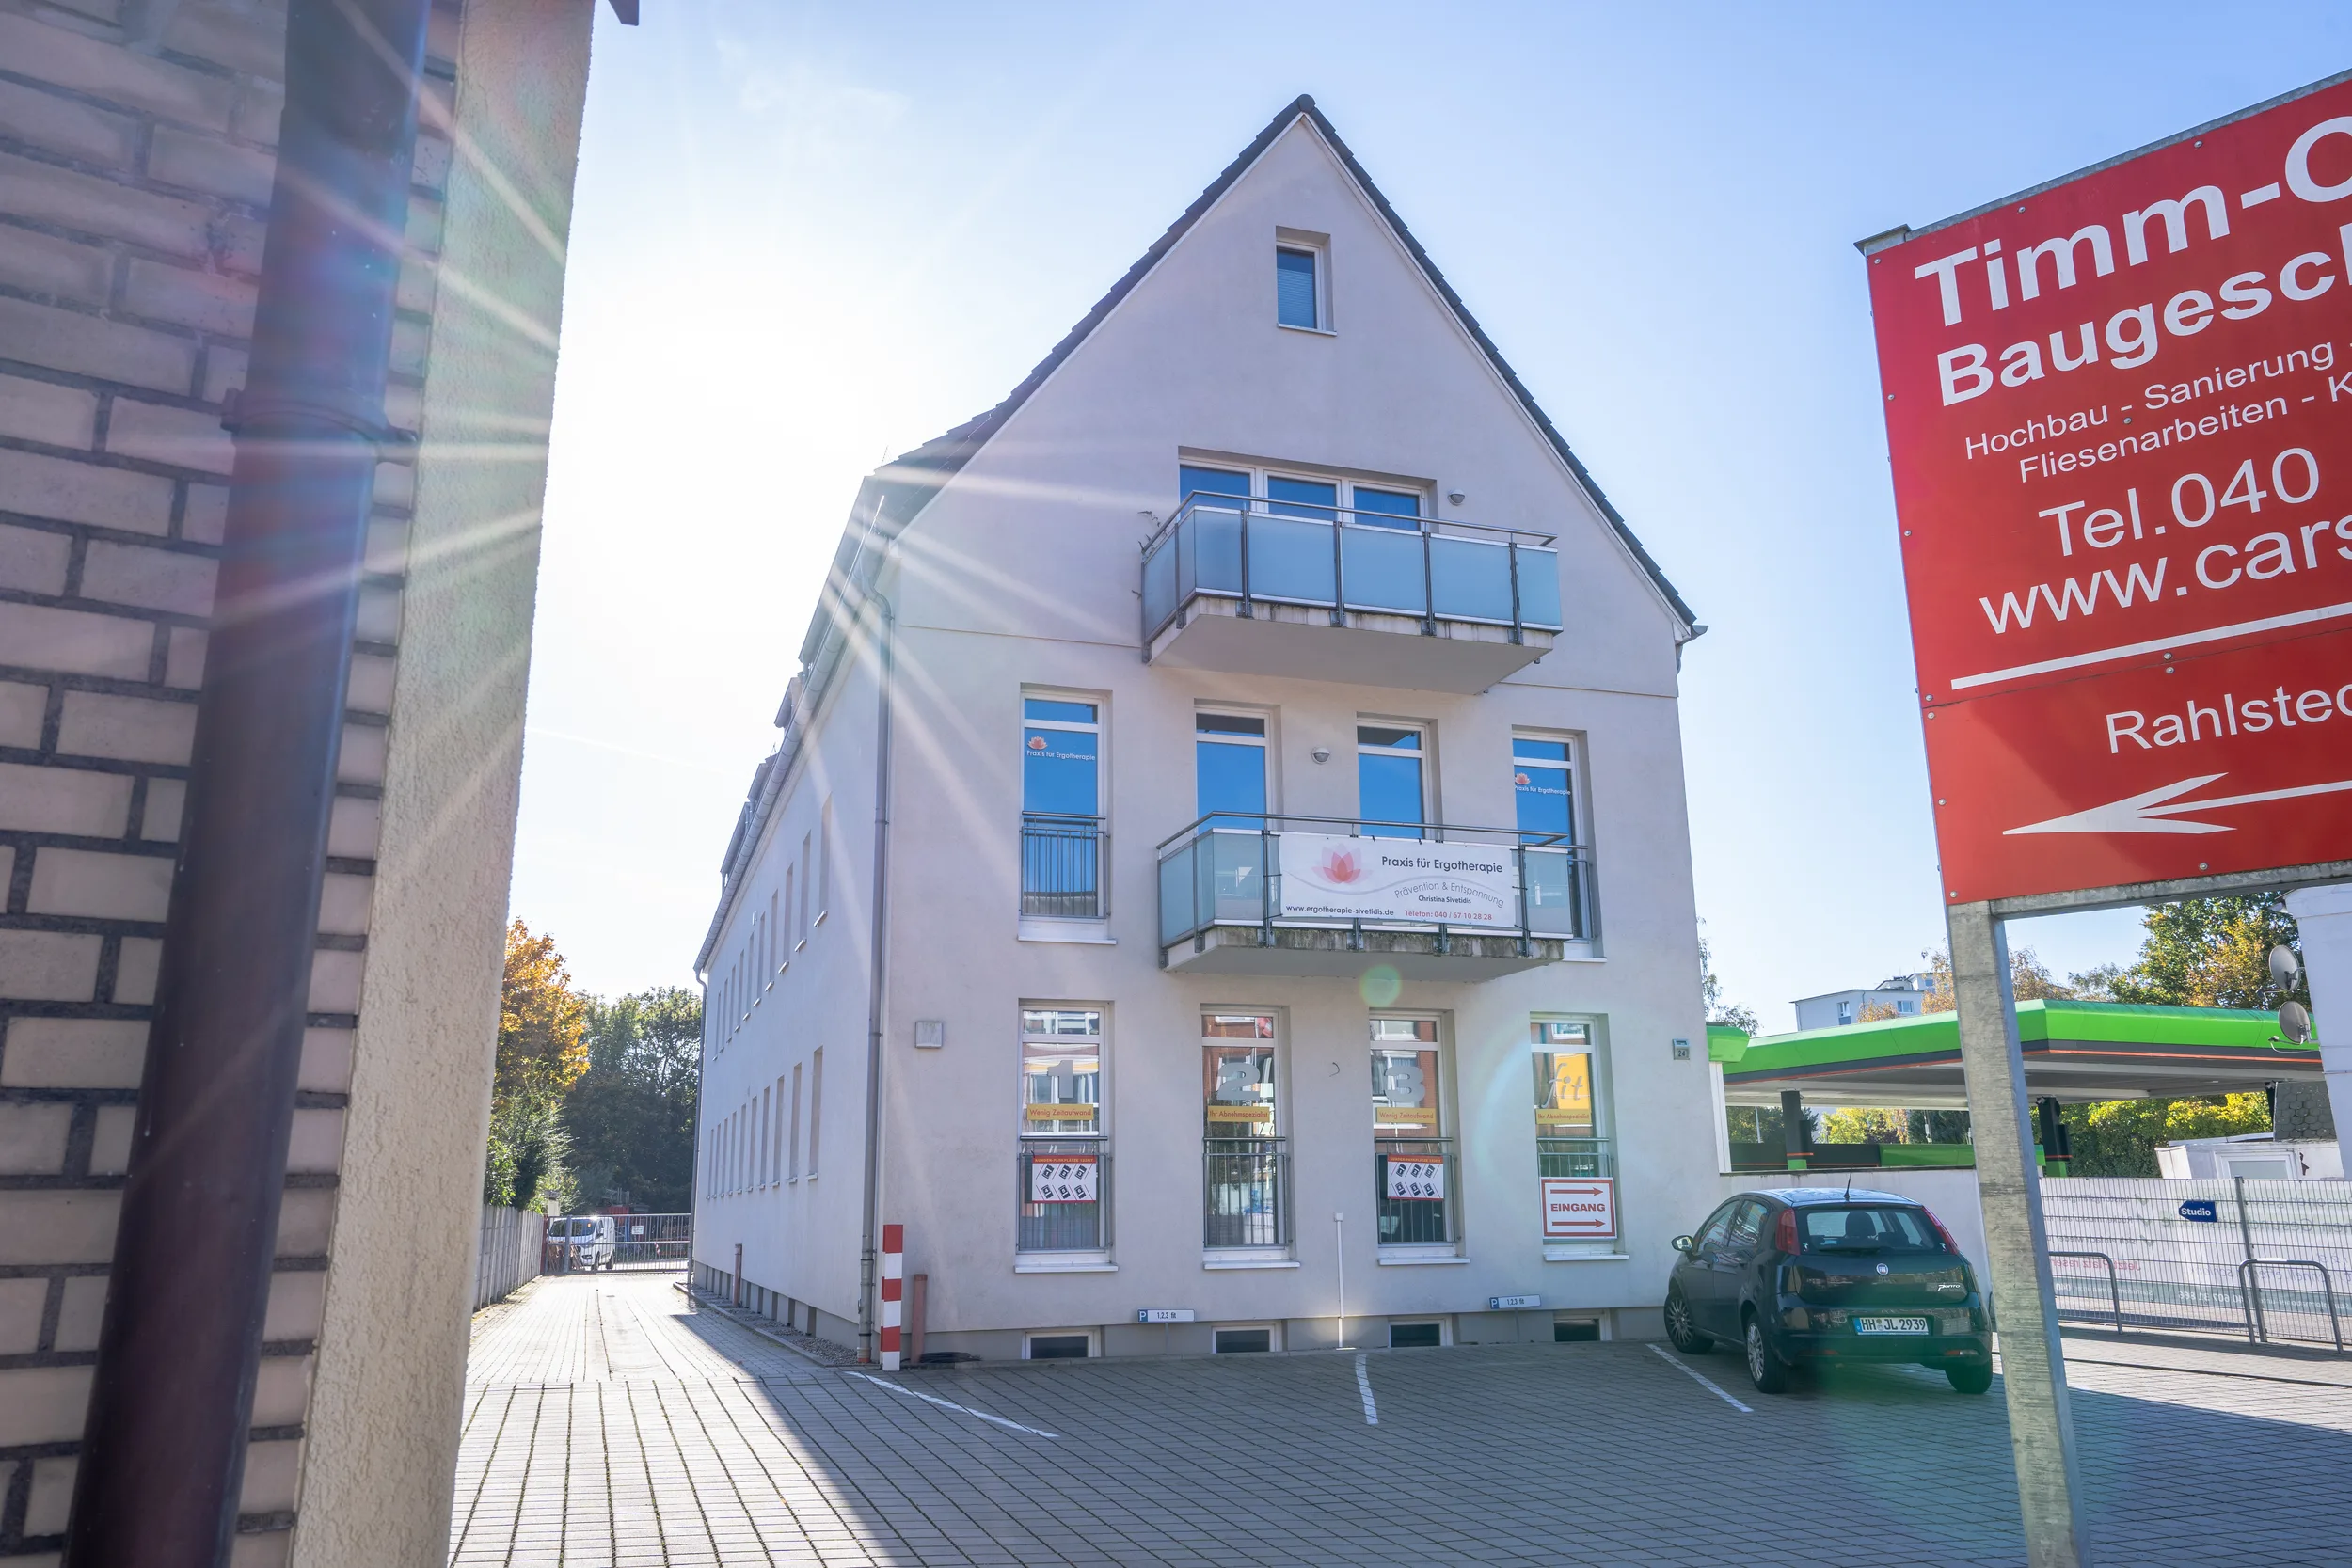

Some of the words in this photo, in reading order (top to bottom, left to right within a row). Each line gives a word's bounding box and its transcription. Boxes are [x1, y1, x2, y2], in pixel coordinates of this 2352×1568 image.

[1936, 222, 2352, 407] Baugesc
[1965, 404, 2109, 460] Hochbau
[2144, 341, 2334, 410] Sanierung
[2019, 396, 2287, 483] Fliesenarbeiten
[1056, 752, 1096, 761] Ergotherapie
[1382, 856, 1414, 868] Praxis
[1416, 858, 1431, 869] für
[1434, 859, 1503, 874] Ergotherapie
[1394, 881, 1439, 899] Prävention
[1441, 882, 1449, 891] &
[1450, 883, 1504, 908] Entspannung
[1418, 895, 1445, 903] Christina
[1285, 904, 1394, 916] www.ergotherapie-sivetidis.de
[1405, 910, 1433, 918] Telefon:
[1047, 1059, 1073, 1099] 1
[1216, 1061, 1261, 1101] 2
[1384, 1065, 1426, 1102] 3
[1540, 1062, 1583, 1109] fit
[1030, 1109, 1051, 1117] Wenig
[1218, 1110, 1268, 1118] Abnehmspezialist
[1550, 1203, 1606, 1212] EINGANG
[2181, 1207, 2211, 1216] Studio
[1491, 1298, 1498, 1308] P
[1139, 1310, 1147, 1322] P
[1861, 1319, 1877, 1330] HH
[1883, 1319, 1899, 1330] JL
[1899, 1319, 1926, 1330] 2939
